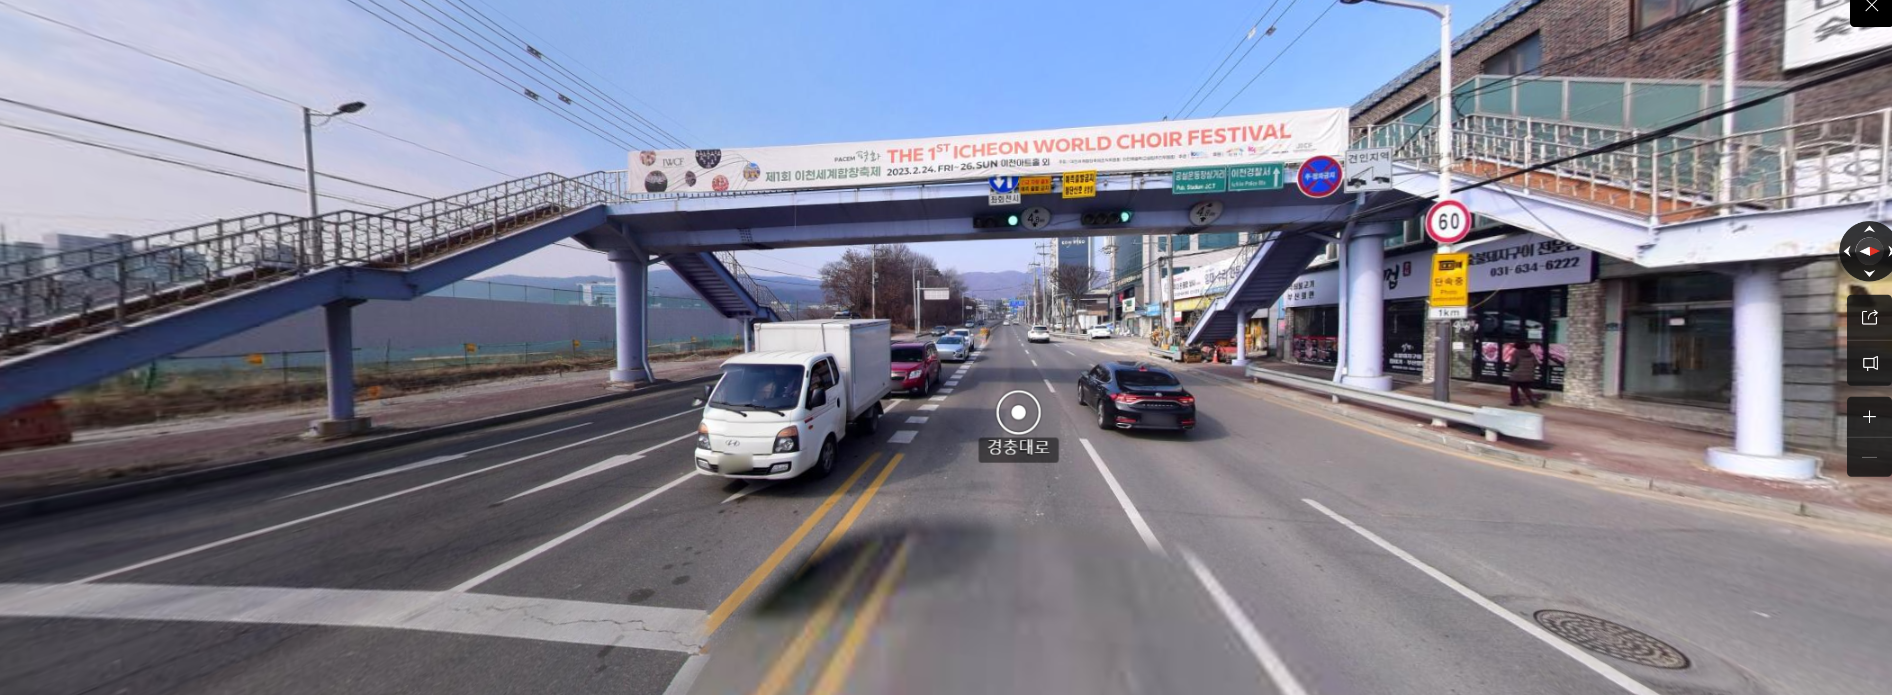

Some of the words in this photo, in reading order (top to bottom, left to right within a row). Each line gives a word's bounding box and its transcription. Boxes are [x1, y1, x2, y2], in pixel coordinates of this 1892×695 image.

[887, 147, 924, 163] THE
[953, 140, 1029, 159] ICHEON
[1033, 135, 1112, 153] WORLD
[1116, 131, 1183, 150] CHOIR
[1187, 122, 1292, 146] FESTIVAL
[1347, 151, 1389, 164] 견인지역
[765, 170, 792, 182] 제1회
[794, 166, 881, 181] 이천세계합창축제
[1231, 166, 1271, 178] 이천경찰서
[1438, 212, 1460, 230] 60
[1490, 257, 1580, 277] 031-634-6222
[1434, 277, 1464, 287] 단속중
[1438, 309, 1461, 317] 1km
